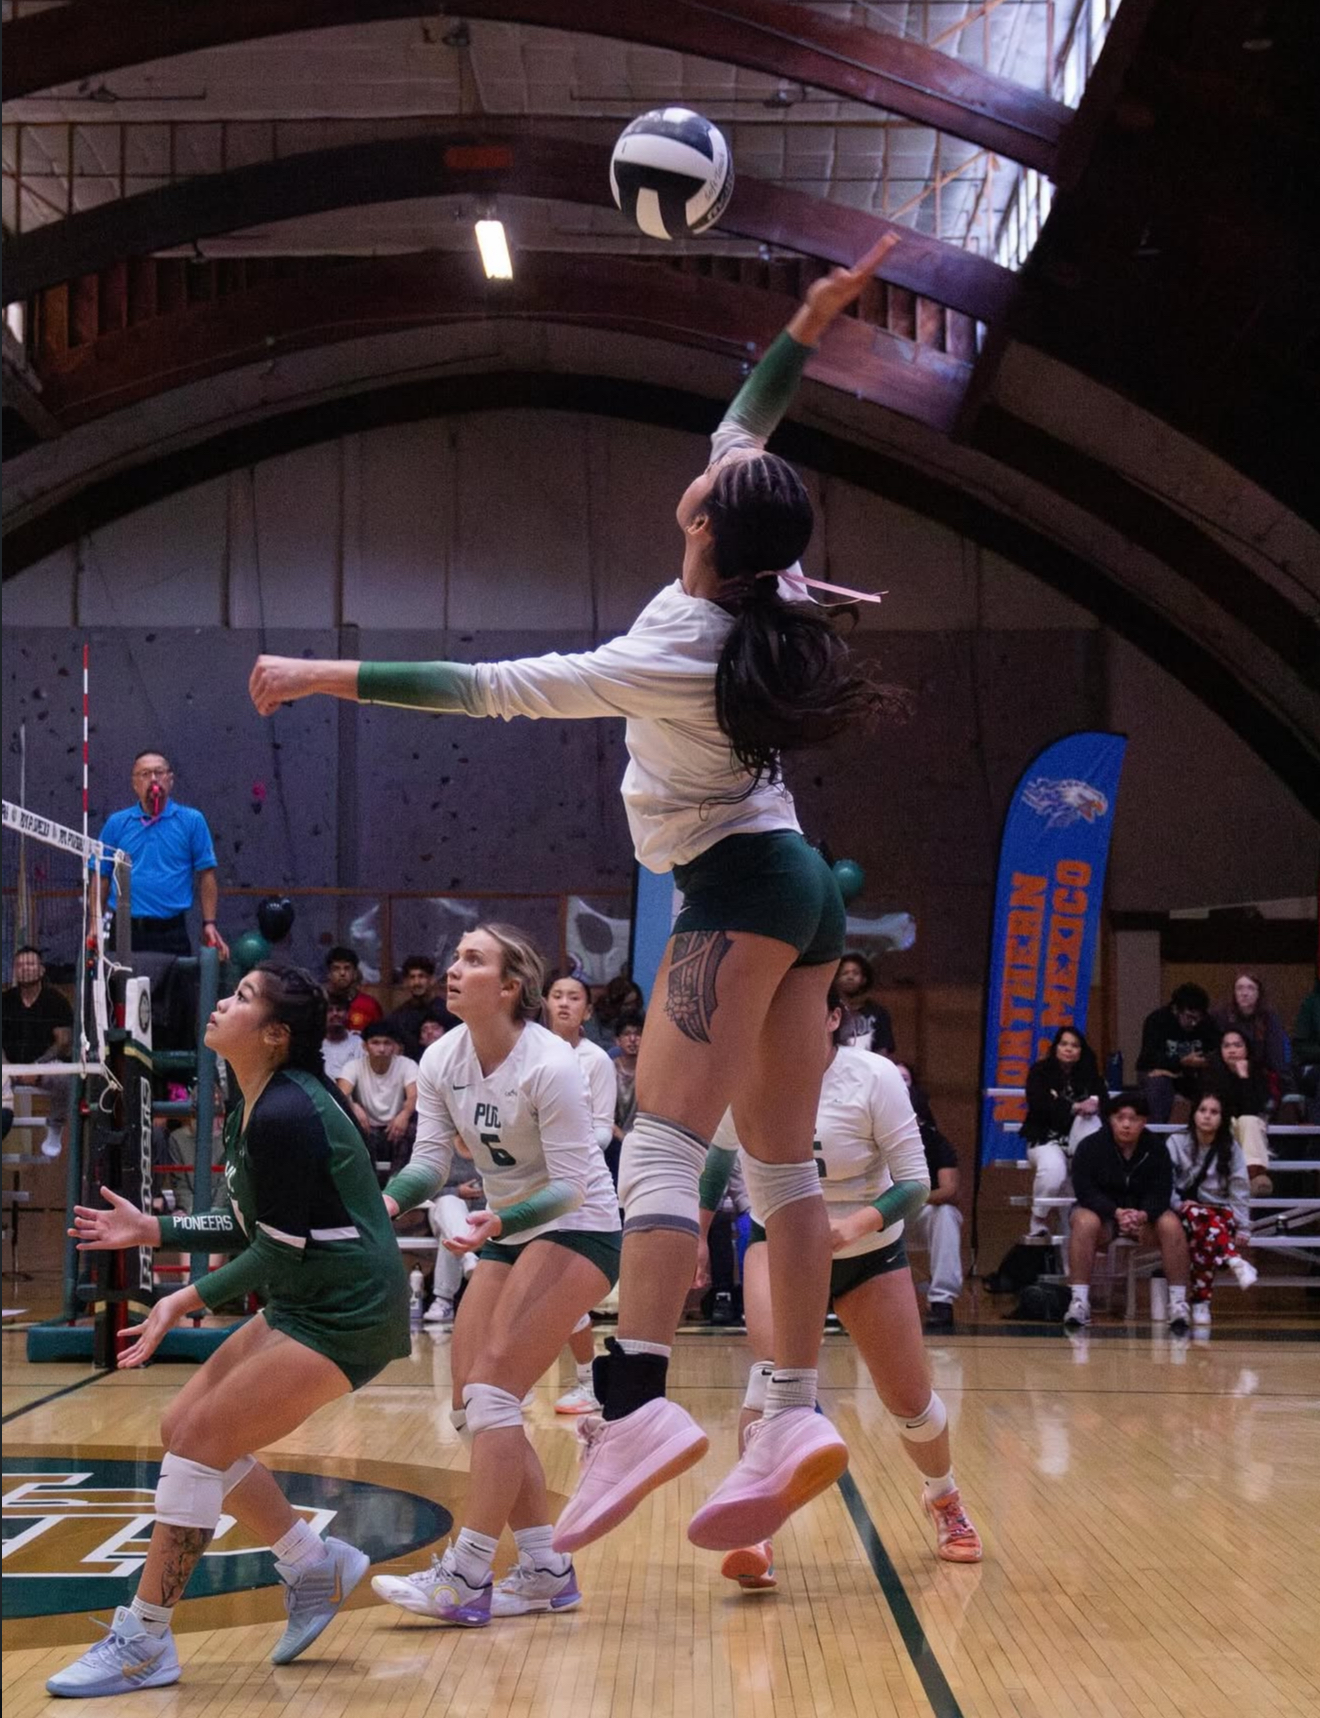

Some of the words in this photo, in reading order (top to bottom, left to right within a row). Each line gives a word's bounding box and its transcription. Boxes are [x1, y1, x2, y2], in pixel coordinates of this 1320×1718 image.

[993, 871, 1048, 1123] NORTHERN
[1039, 859, 1092, 1027] MEXICO
[172, 1215, 233, 1231] PIONEERS
